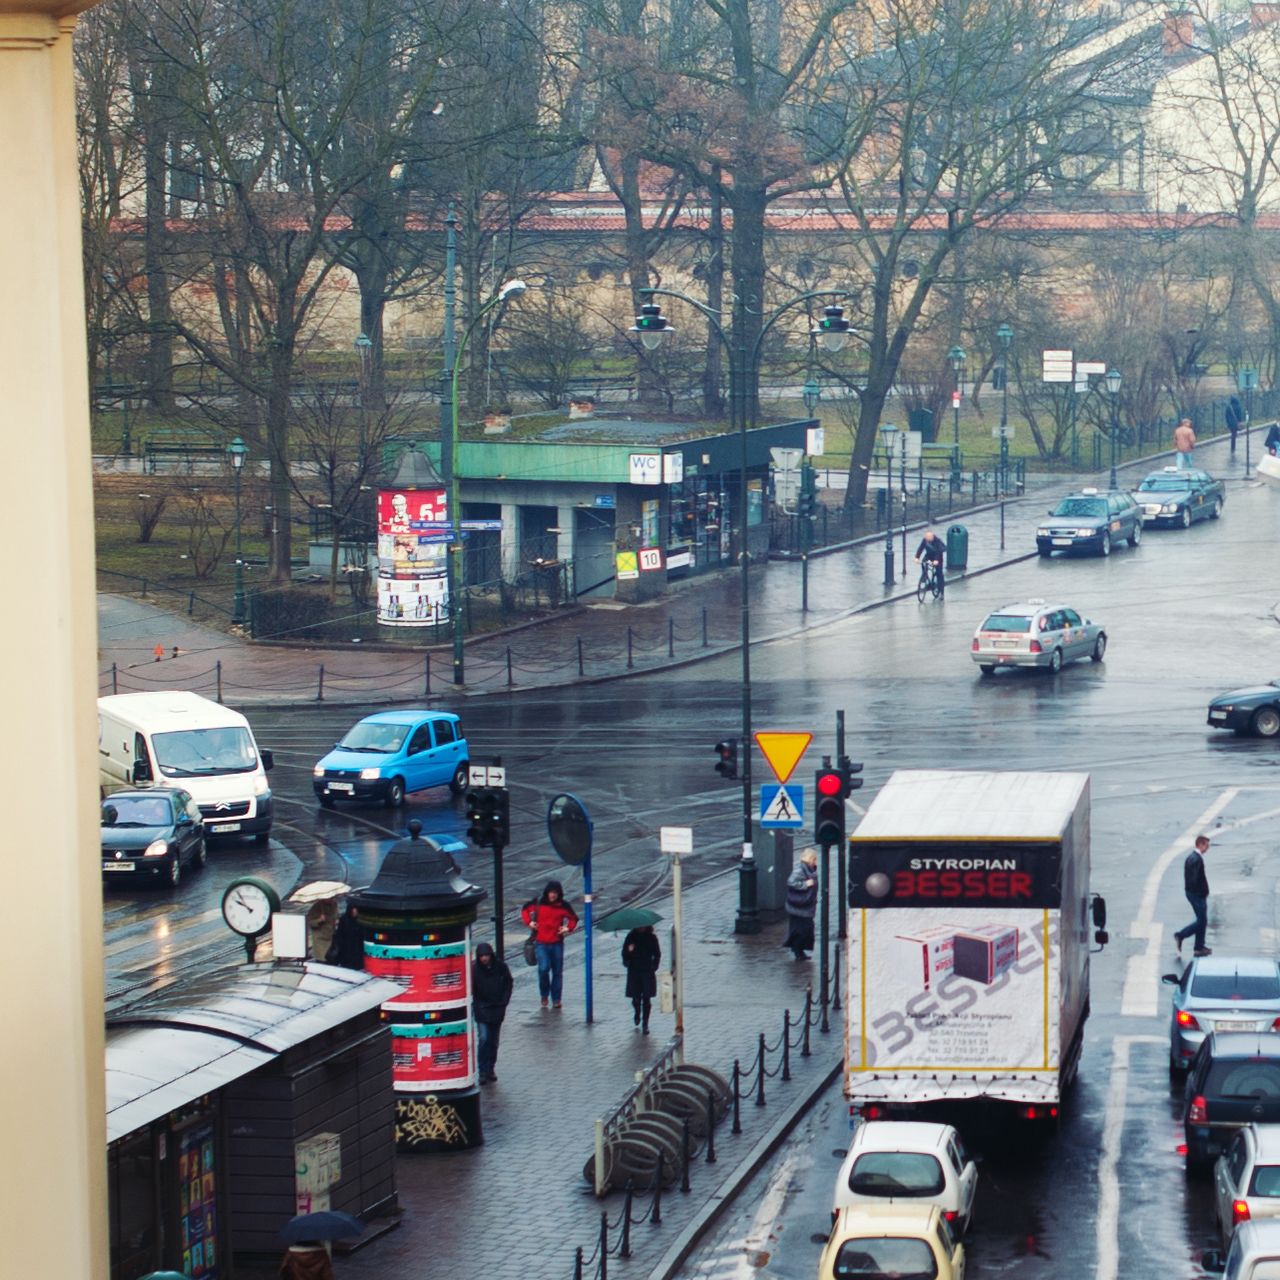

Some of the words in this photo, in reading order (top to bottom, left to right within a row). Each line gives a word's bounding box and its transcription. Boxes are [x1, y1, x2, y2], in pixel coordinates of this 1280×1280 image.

[632, 456, 657, 469] WC
[644, 552, 658, 566] 10
[910, 858, 1016, 870] STYROPIAN
[894, 872, 1033, 898] BESSER
